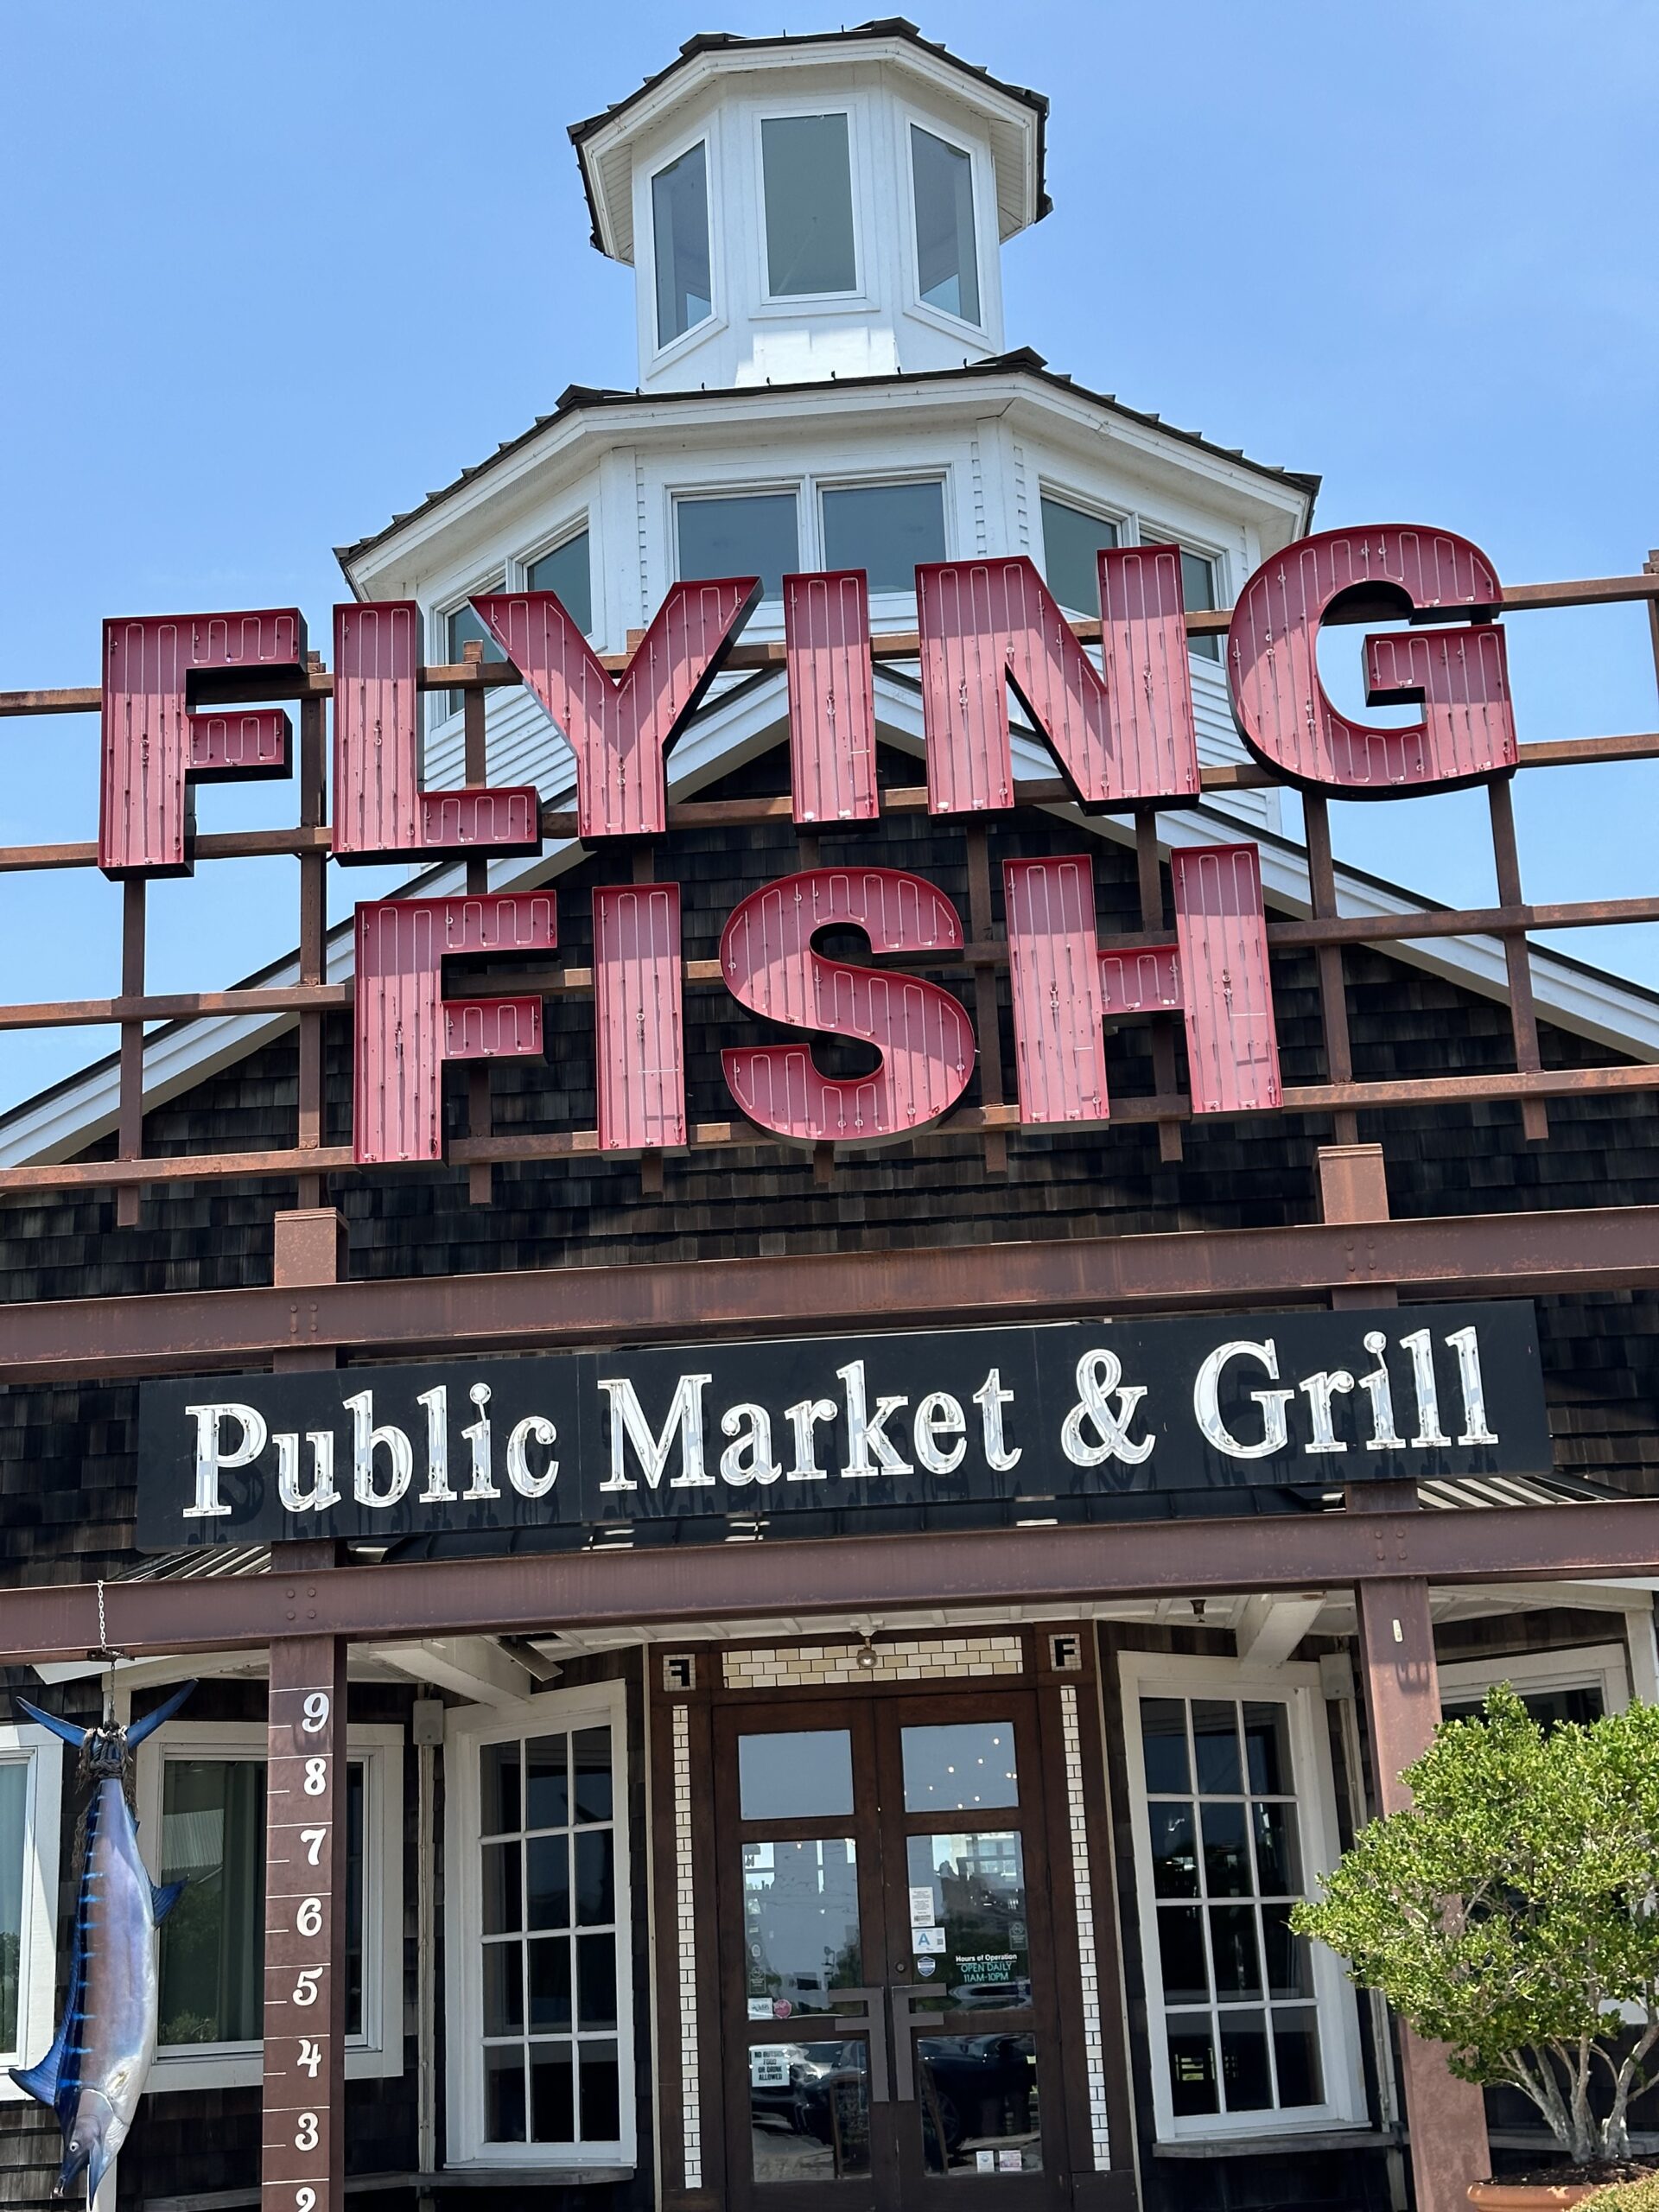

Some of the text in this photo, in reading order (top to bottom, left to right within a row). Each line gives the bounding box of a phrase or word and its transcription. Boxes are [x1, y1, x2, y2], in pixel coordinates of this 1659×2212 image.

[99, 523, 1519, 880] FLYING
[353, 842, 1284, 1172] FISH
[182, 1325, 1500, 1518] Public Market & Grill
[1054, 1638, 1076, 1667] F
[302, 1692, 329, 1733] 9
[303, 1758, 327, 1796] 8
[300, 1828, 327, 1866] 7
[296, 1897, 322, 1936] 6
[918, 1932, 931, 1946] A
[985, 1953, 1018, 1961] Operation
[292, 1967, 323, 2005] 5
[960, 1961, 1012, 1973] OPEN DAILY
[963, 1972, 1009, 1983] 11AM-10PM
[296, 2039, 322, 2078] 4
[295, 2112, 319, 2151] 3
[296, 2187, 316, 2212] 2
